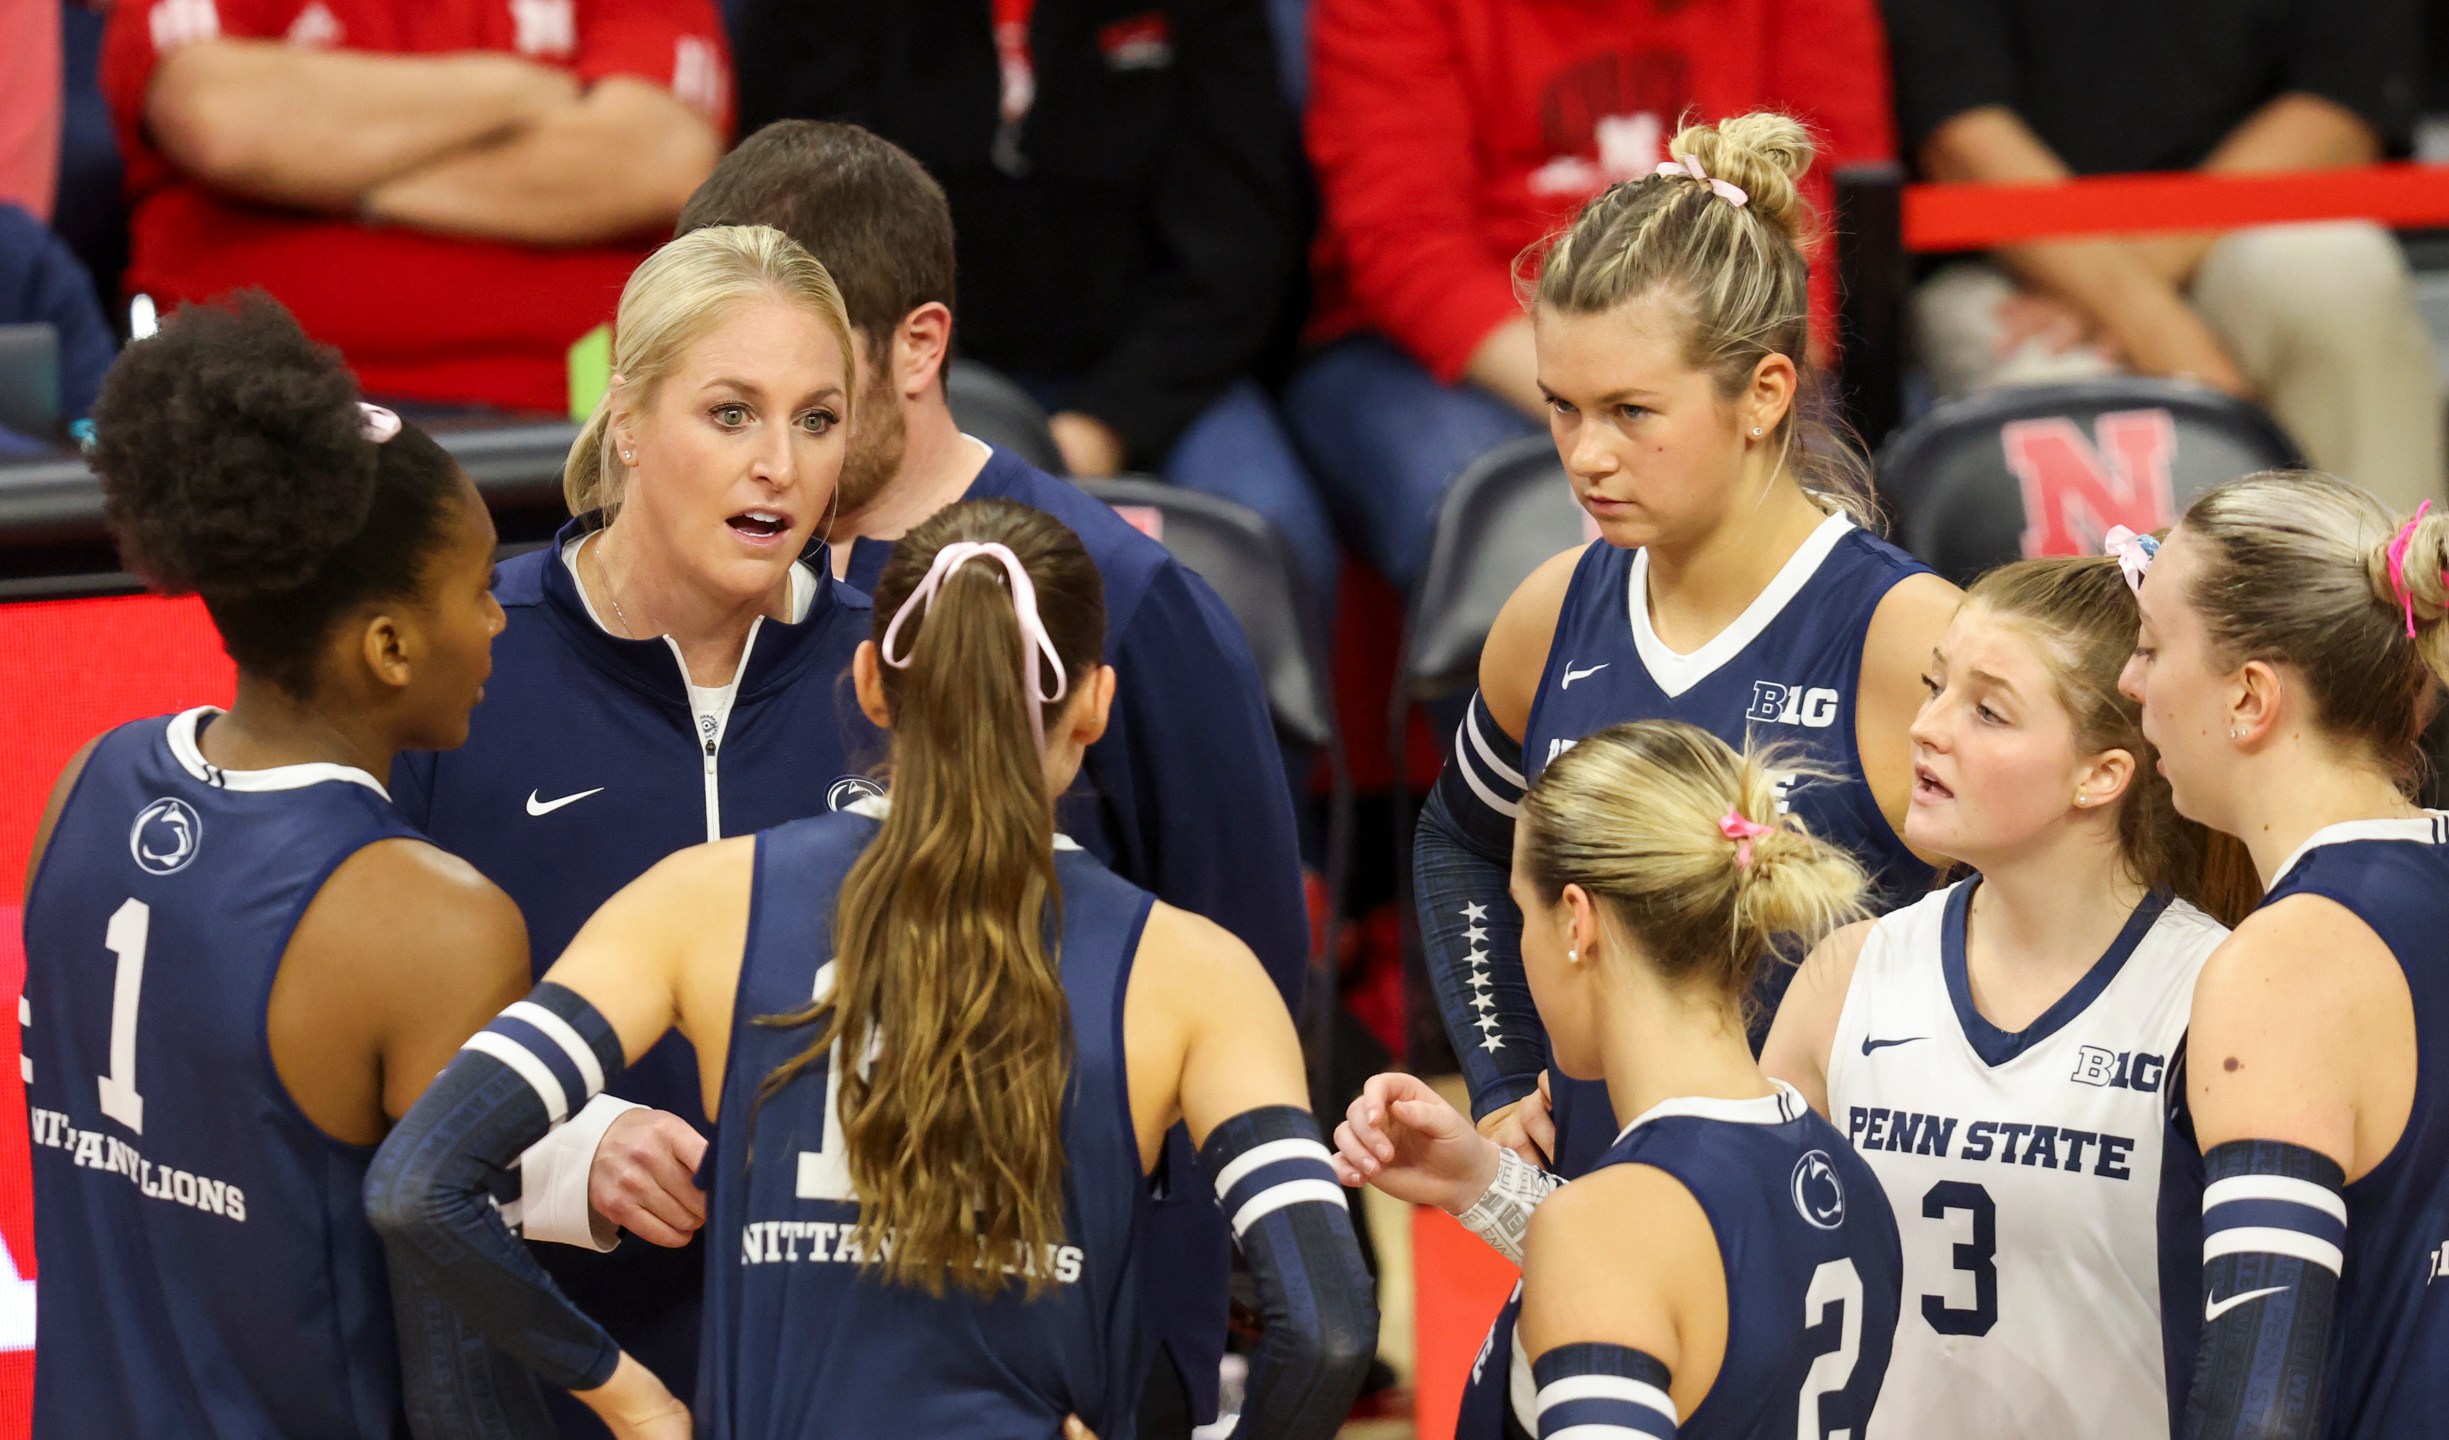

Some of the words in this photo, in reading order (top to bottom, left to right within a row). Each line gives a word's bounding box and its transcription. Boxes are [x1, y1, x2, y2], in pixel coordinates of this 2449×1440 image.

[2002, 408, 2178, 560] N
[98, 896, 149, 1137] 1
[141, 1158, 247, 1223] LIONS
[1849, 1106, 1958, 1158] PENN
[1961, 1121, 2135, 1181] STATE
[1921, 1180, 1998, 1338] 3
[1797, 1257, 1864, 1440] 2
